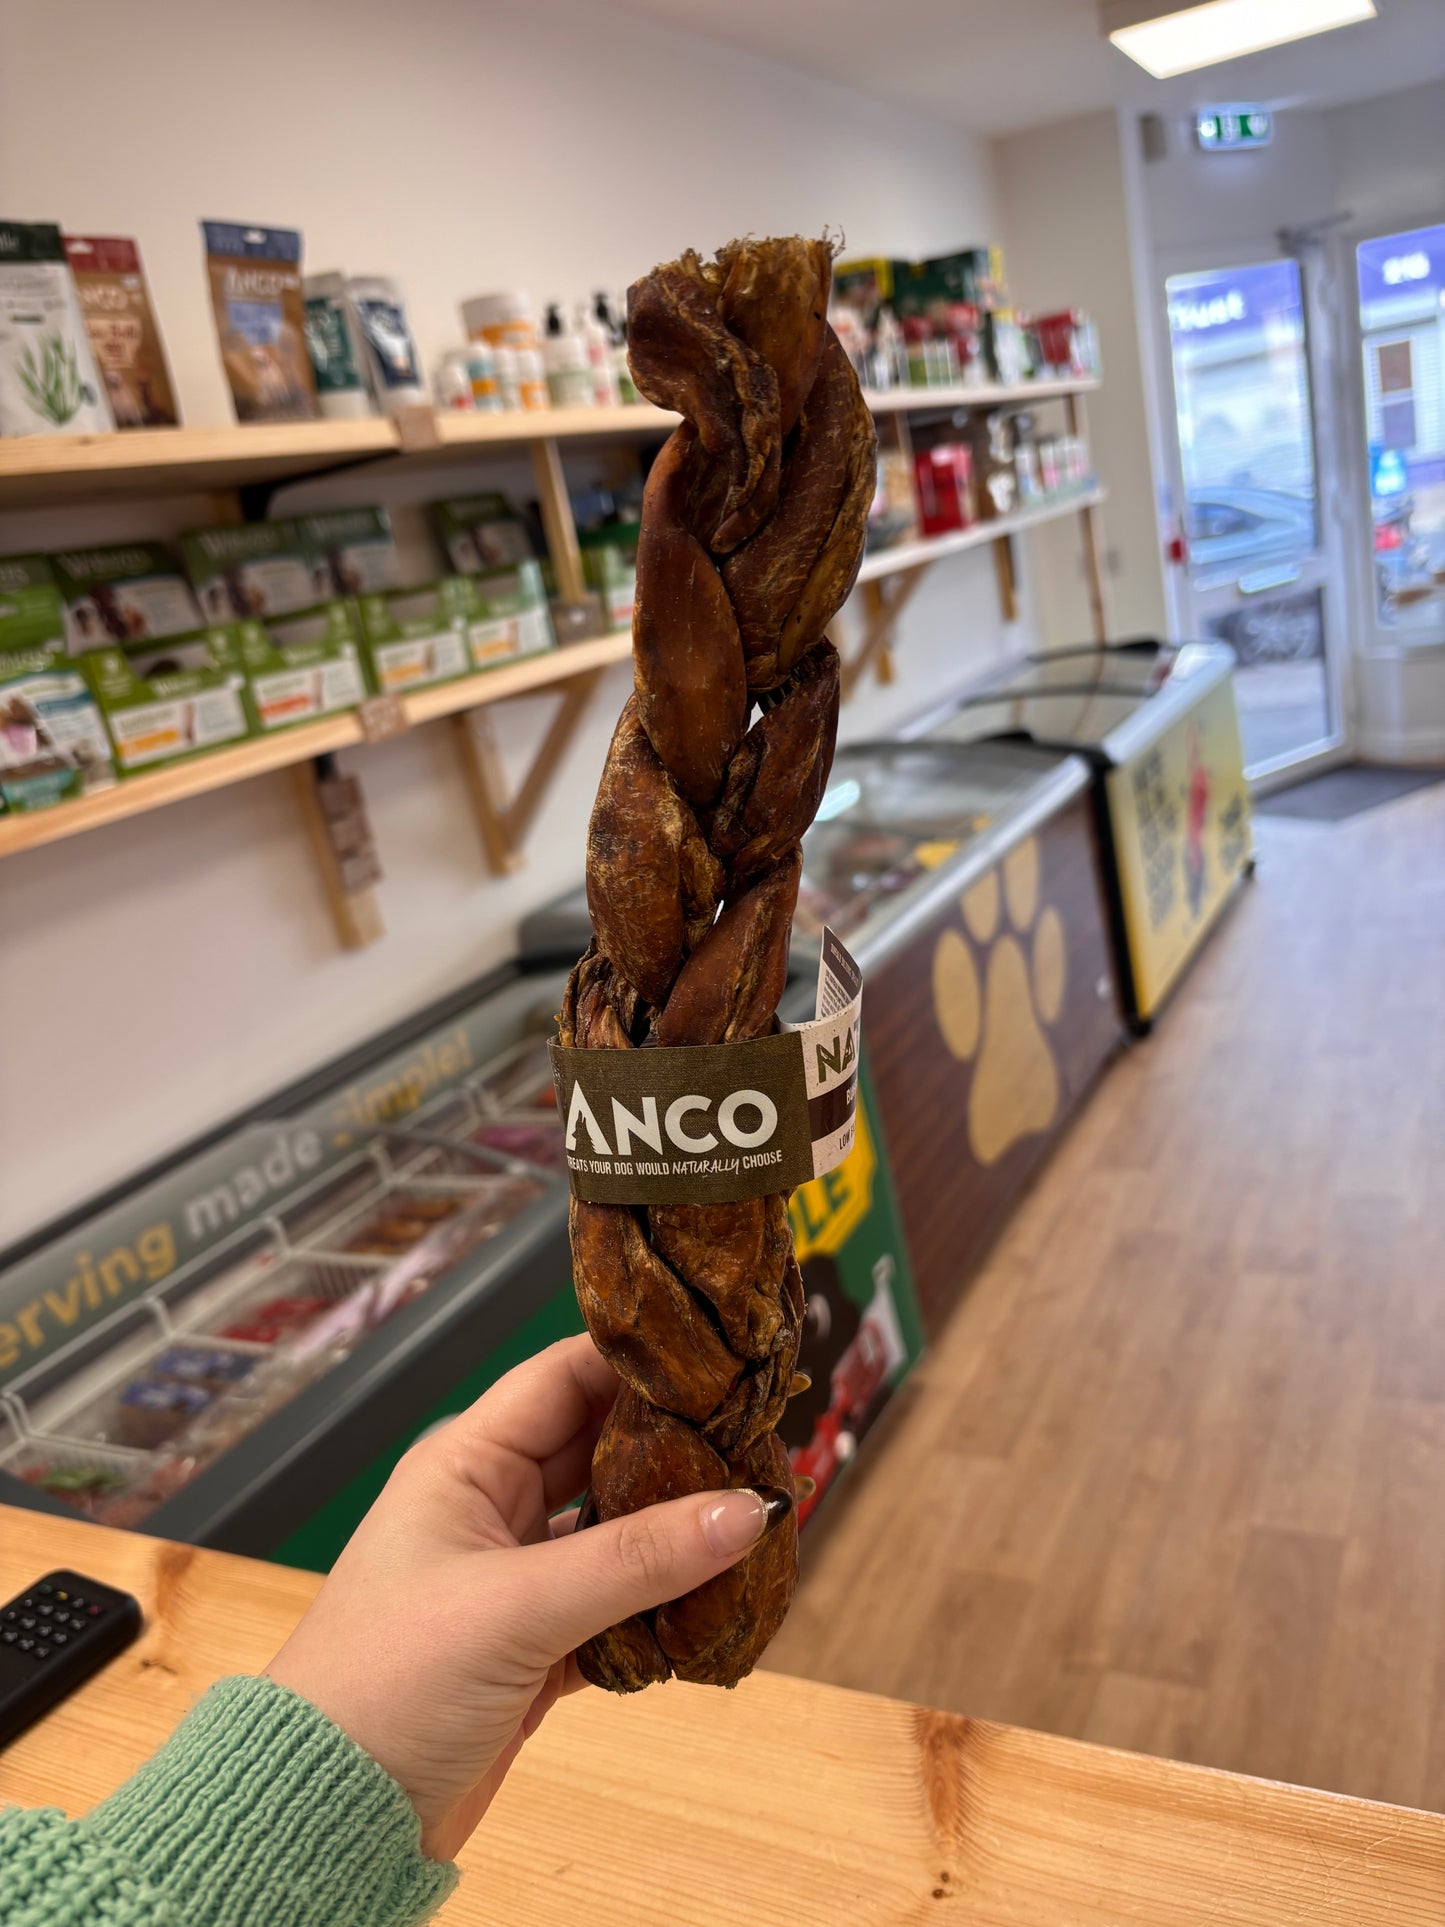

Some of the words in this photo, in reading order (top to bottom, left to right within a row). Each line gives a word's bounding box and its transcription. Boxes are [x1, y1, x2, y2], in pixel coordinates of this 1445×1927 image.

[565, 1080, 778, 1156] ANCO
[183, 1130, 323, 1240] made
[588, 1160, 612, 1175] YOUR
[615, 1162, 633, 1175] DOG
[636, 1162, 669, 1175] WOULD
[672, 1157, 739, 1178] NATURALLY
[743, 1150, 782, 1170] CHOOSE
